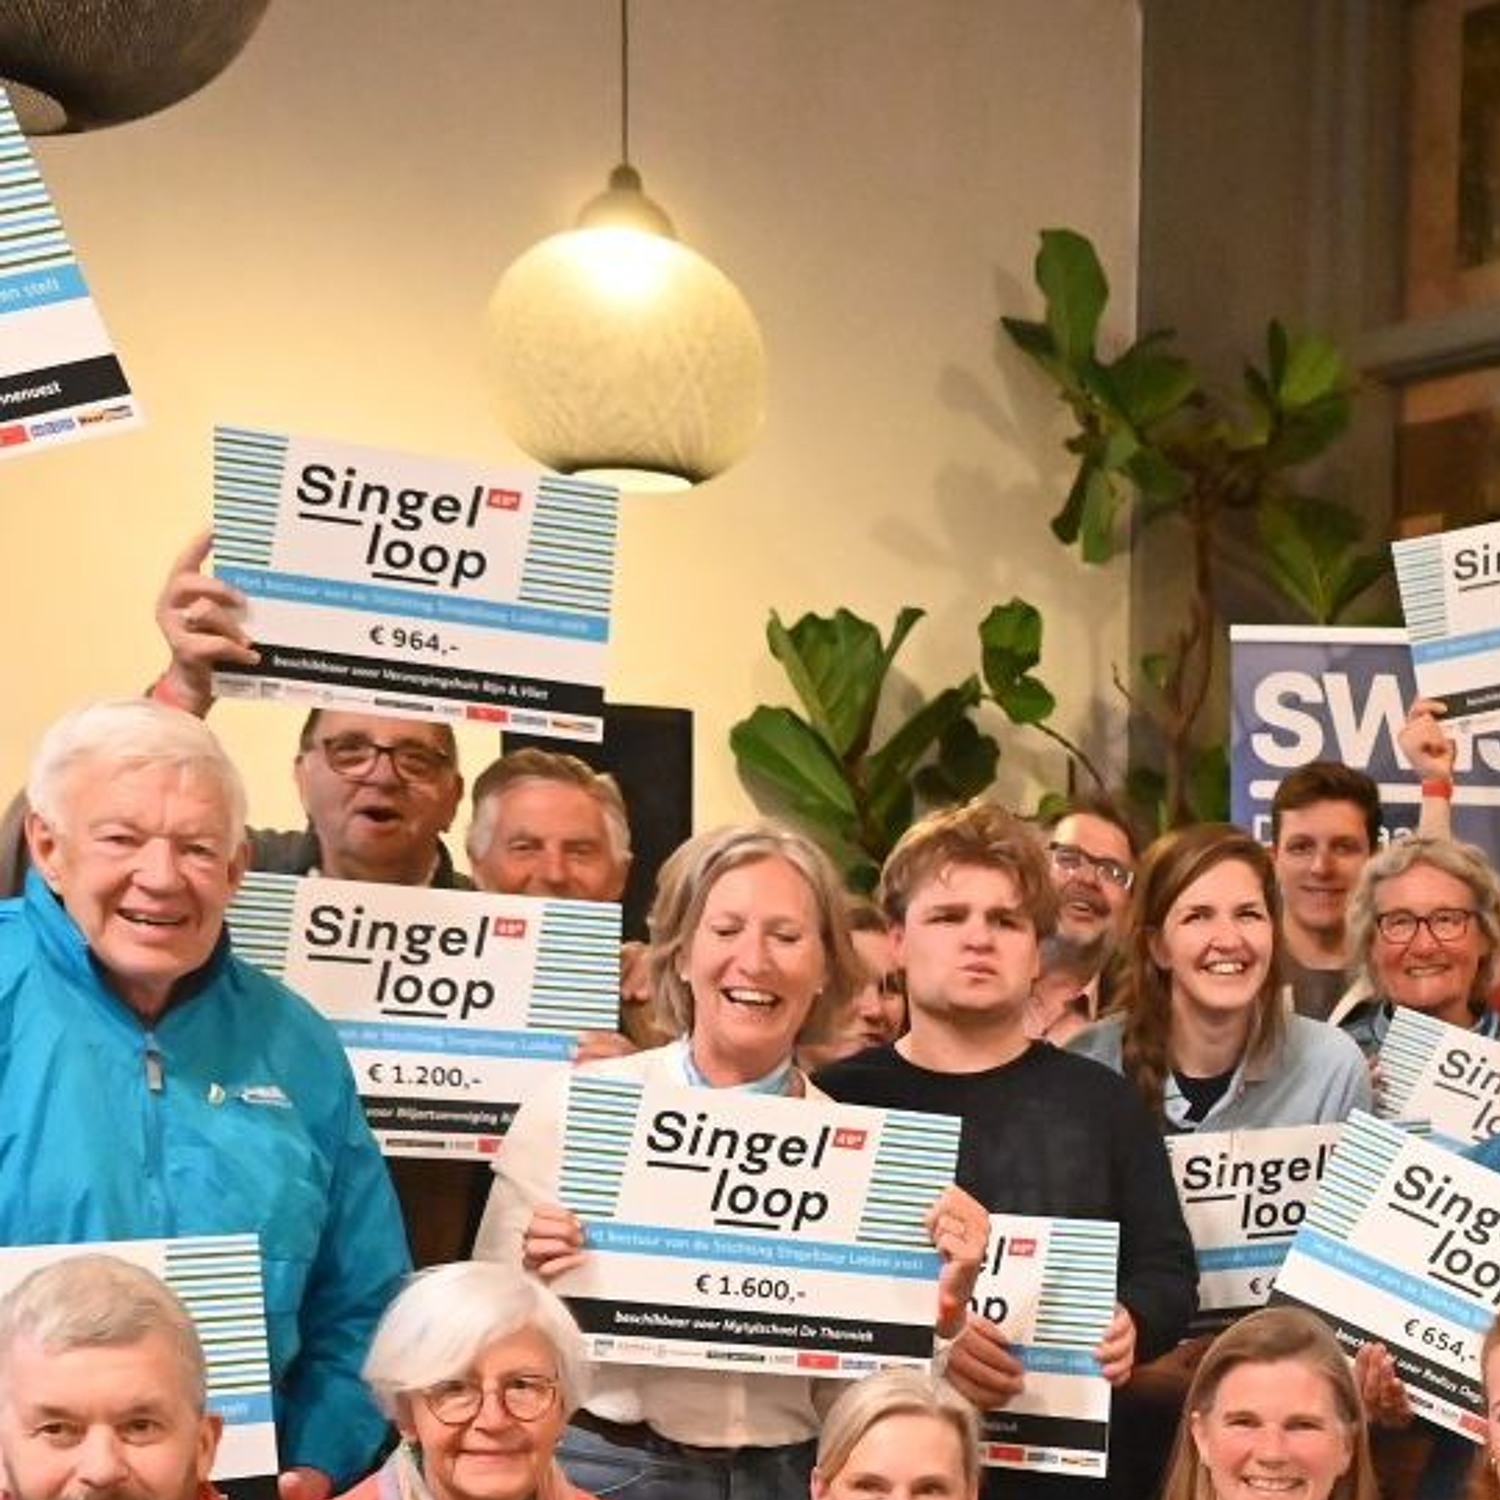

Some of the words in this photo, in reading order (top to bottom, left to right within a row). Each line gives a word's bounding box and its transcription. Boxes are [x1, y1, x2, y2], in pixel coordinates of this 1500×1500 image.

[297, 464, 484, 530] Singel
[366, 523, 486, 588] loop
[369, 625, 384, 645] €
[391, 628, 460, 657] 964,-
[305, 905, 489, 965] Singel
[376, 961, 494, 1019] loop
[368, 1063, 383, 1081] €
[392, 1064, 482, 1089] 1.200,-
[647, 1110, 831, 1175] Singel
[1183, 1144, 1326, 1195] Singel
[711, 1169, 829, 1231] loop
[1241, 1194, 1306, 1229] loo
[694, 1273, 711, 1294] €
[718, 1275, 808, 1304] 1.600,-
[1401, 1315, 1420, 1337] €
[1419, 1324, 1480, 1366] 654,-
